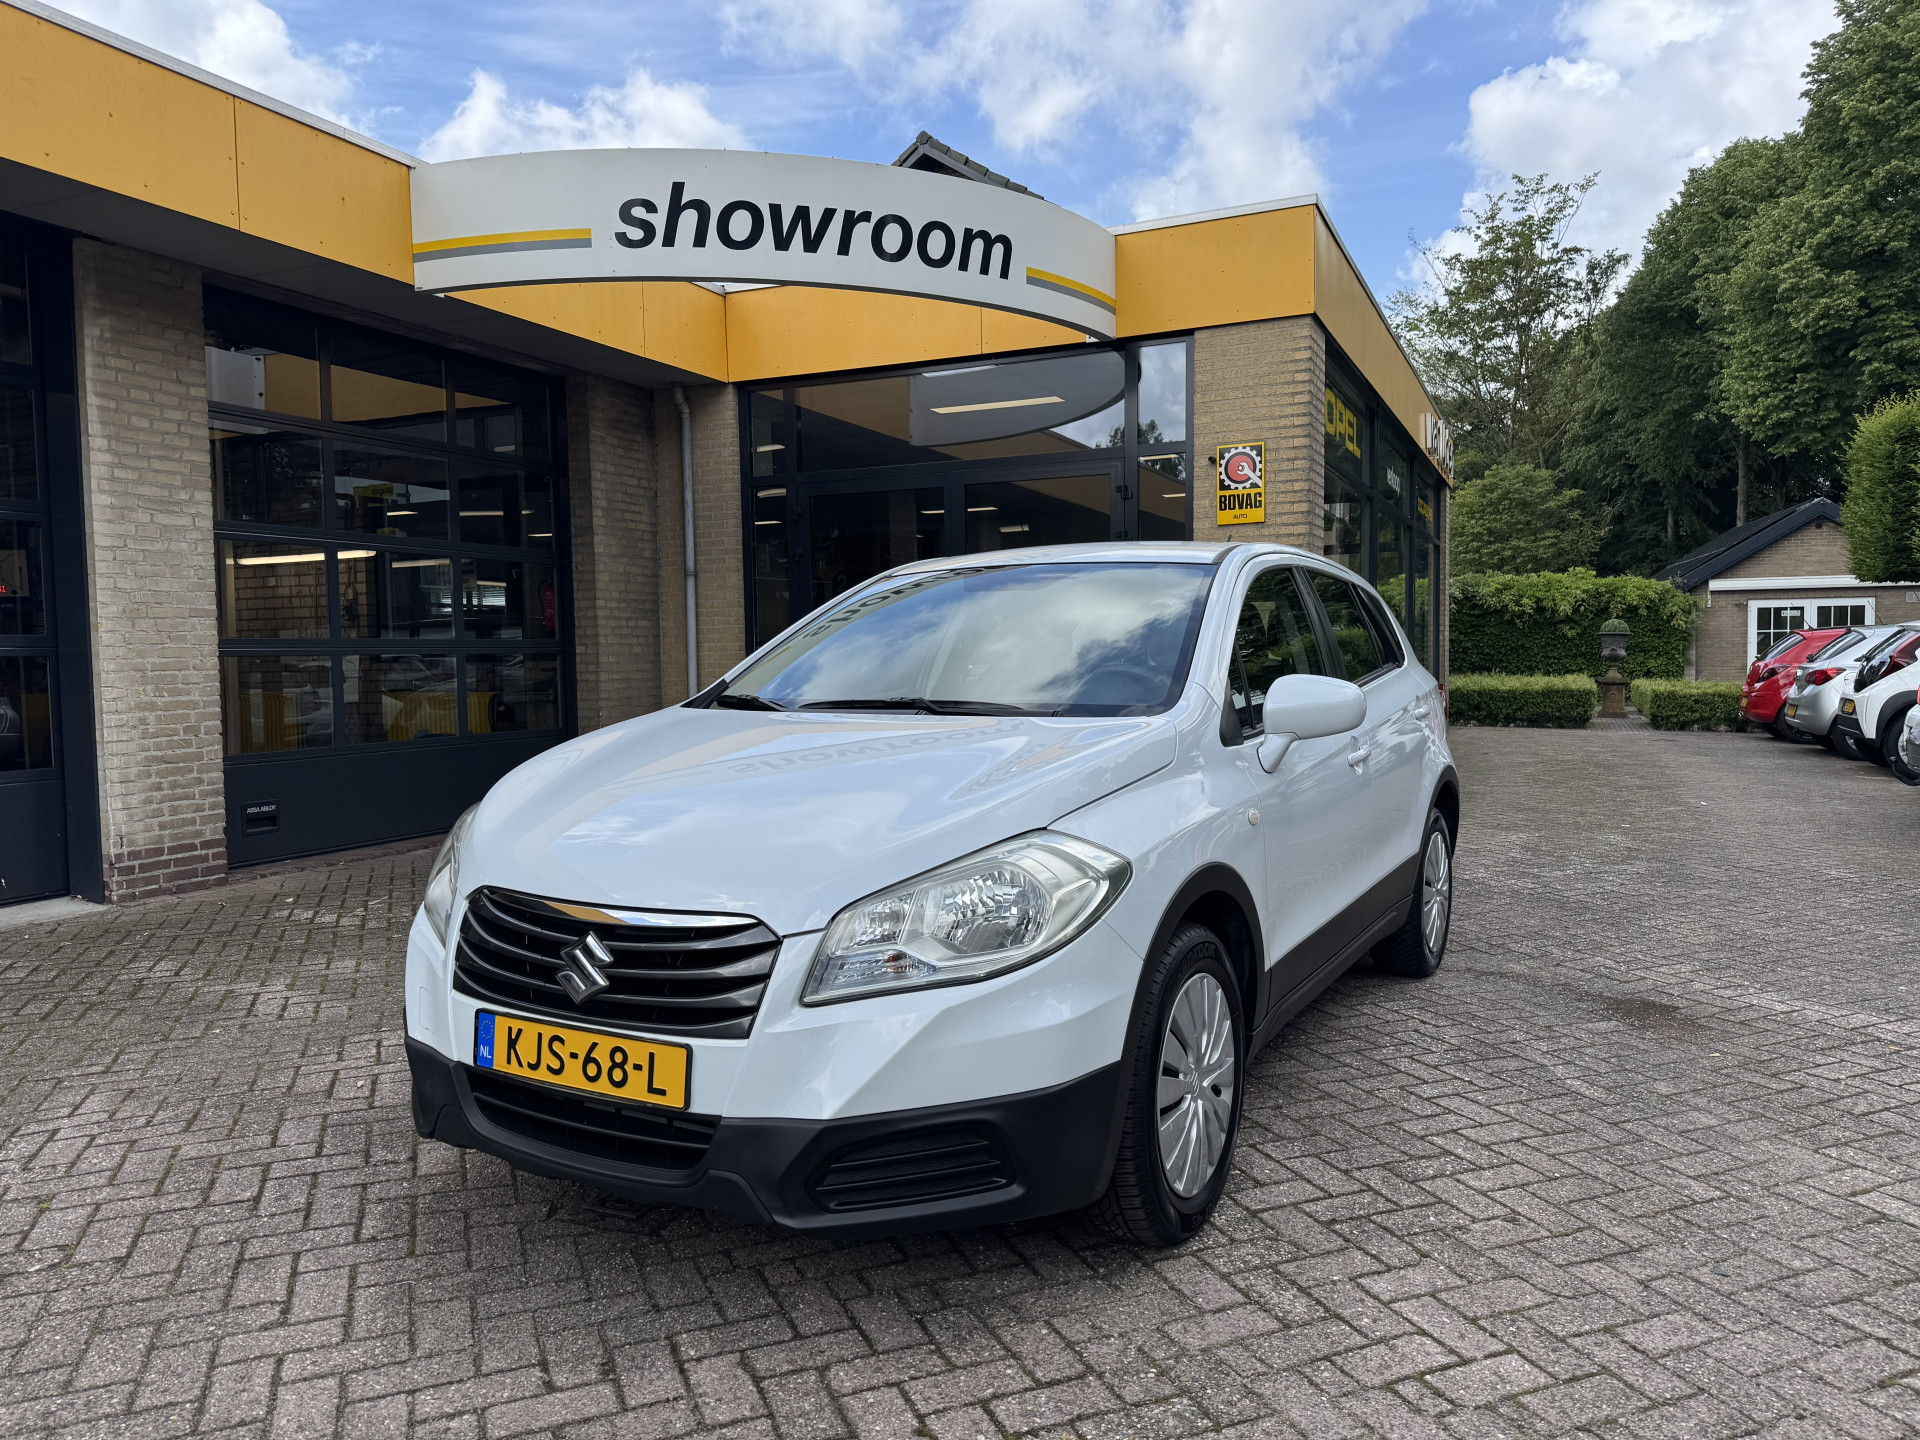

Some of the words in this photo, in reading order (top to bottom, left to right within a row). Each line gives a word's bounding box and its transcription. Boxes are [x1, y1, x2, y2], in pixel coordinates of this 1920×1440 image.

[614, 181, 1012, 280] showroom
[1325, 387, 1361, 459] OPEL
[1219, 492, 1262, 511] BOVAG
[479, 1044, 492, 1059] NL
[506, 1025, 667, 1096] KJS-68-L
